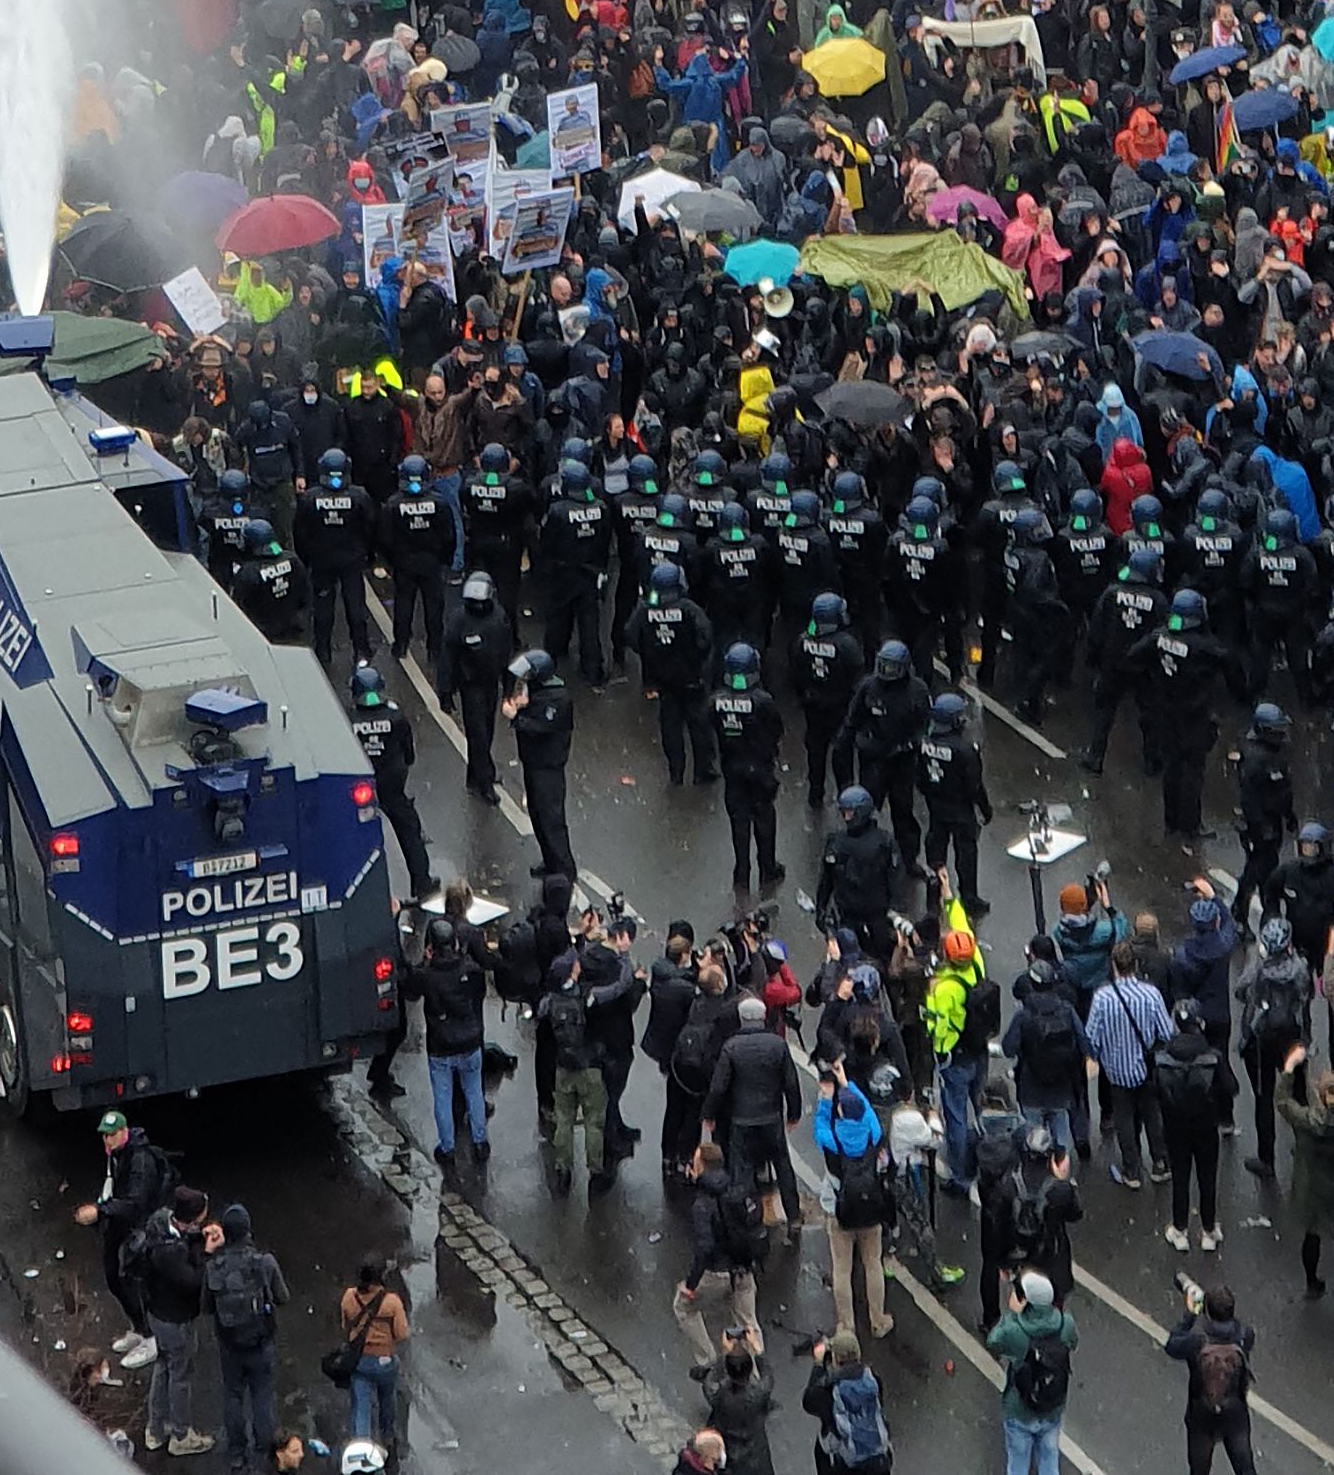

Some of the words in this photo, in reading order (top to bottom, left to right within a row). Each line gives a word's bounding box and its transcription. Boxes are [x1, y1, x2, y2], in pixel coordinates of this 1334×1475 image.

[470, 485, 506, 499] POLIZEI
[316, 497, 351, 510] POLIZEI
[399, 501, 436, 516] POLIZEI
[756, 497, 791, 511] POLIZEI
[568, 507, 601, 523] POLIZEI
[622, 505, 657, 518] POLIZEI
[829, 520, 865, 535] POLIZEI
[645, 536, 679, 552] POLIZEI
[1070, 537, 1106, 551] POLIZEI
[1195, 536, 1232, 551] POLIZEI
[720, 548, 756, 564] POLIZEI
[900, 543, 934, 560] POLIZEI
[259, 560, 292, 582] POLIZEI
[1260, 556, 1296, 572] POLIZEI
[1116, 591, 1153, 611] POLIZEI
[648, 608, 682, 622] POLIZEI
[803, 639, 835, 657] POLIZEI
[715, 698, 752, 714] POLIZEI
[353, 720, 391, 735] POLIZEI
[221, 857, 246, 870] 7212
[163, 871, 297, 923] POLIZEI
[162, 922, 304, 1000] BE3
